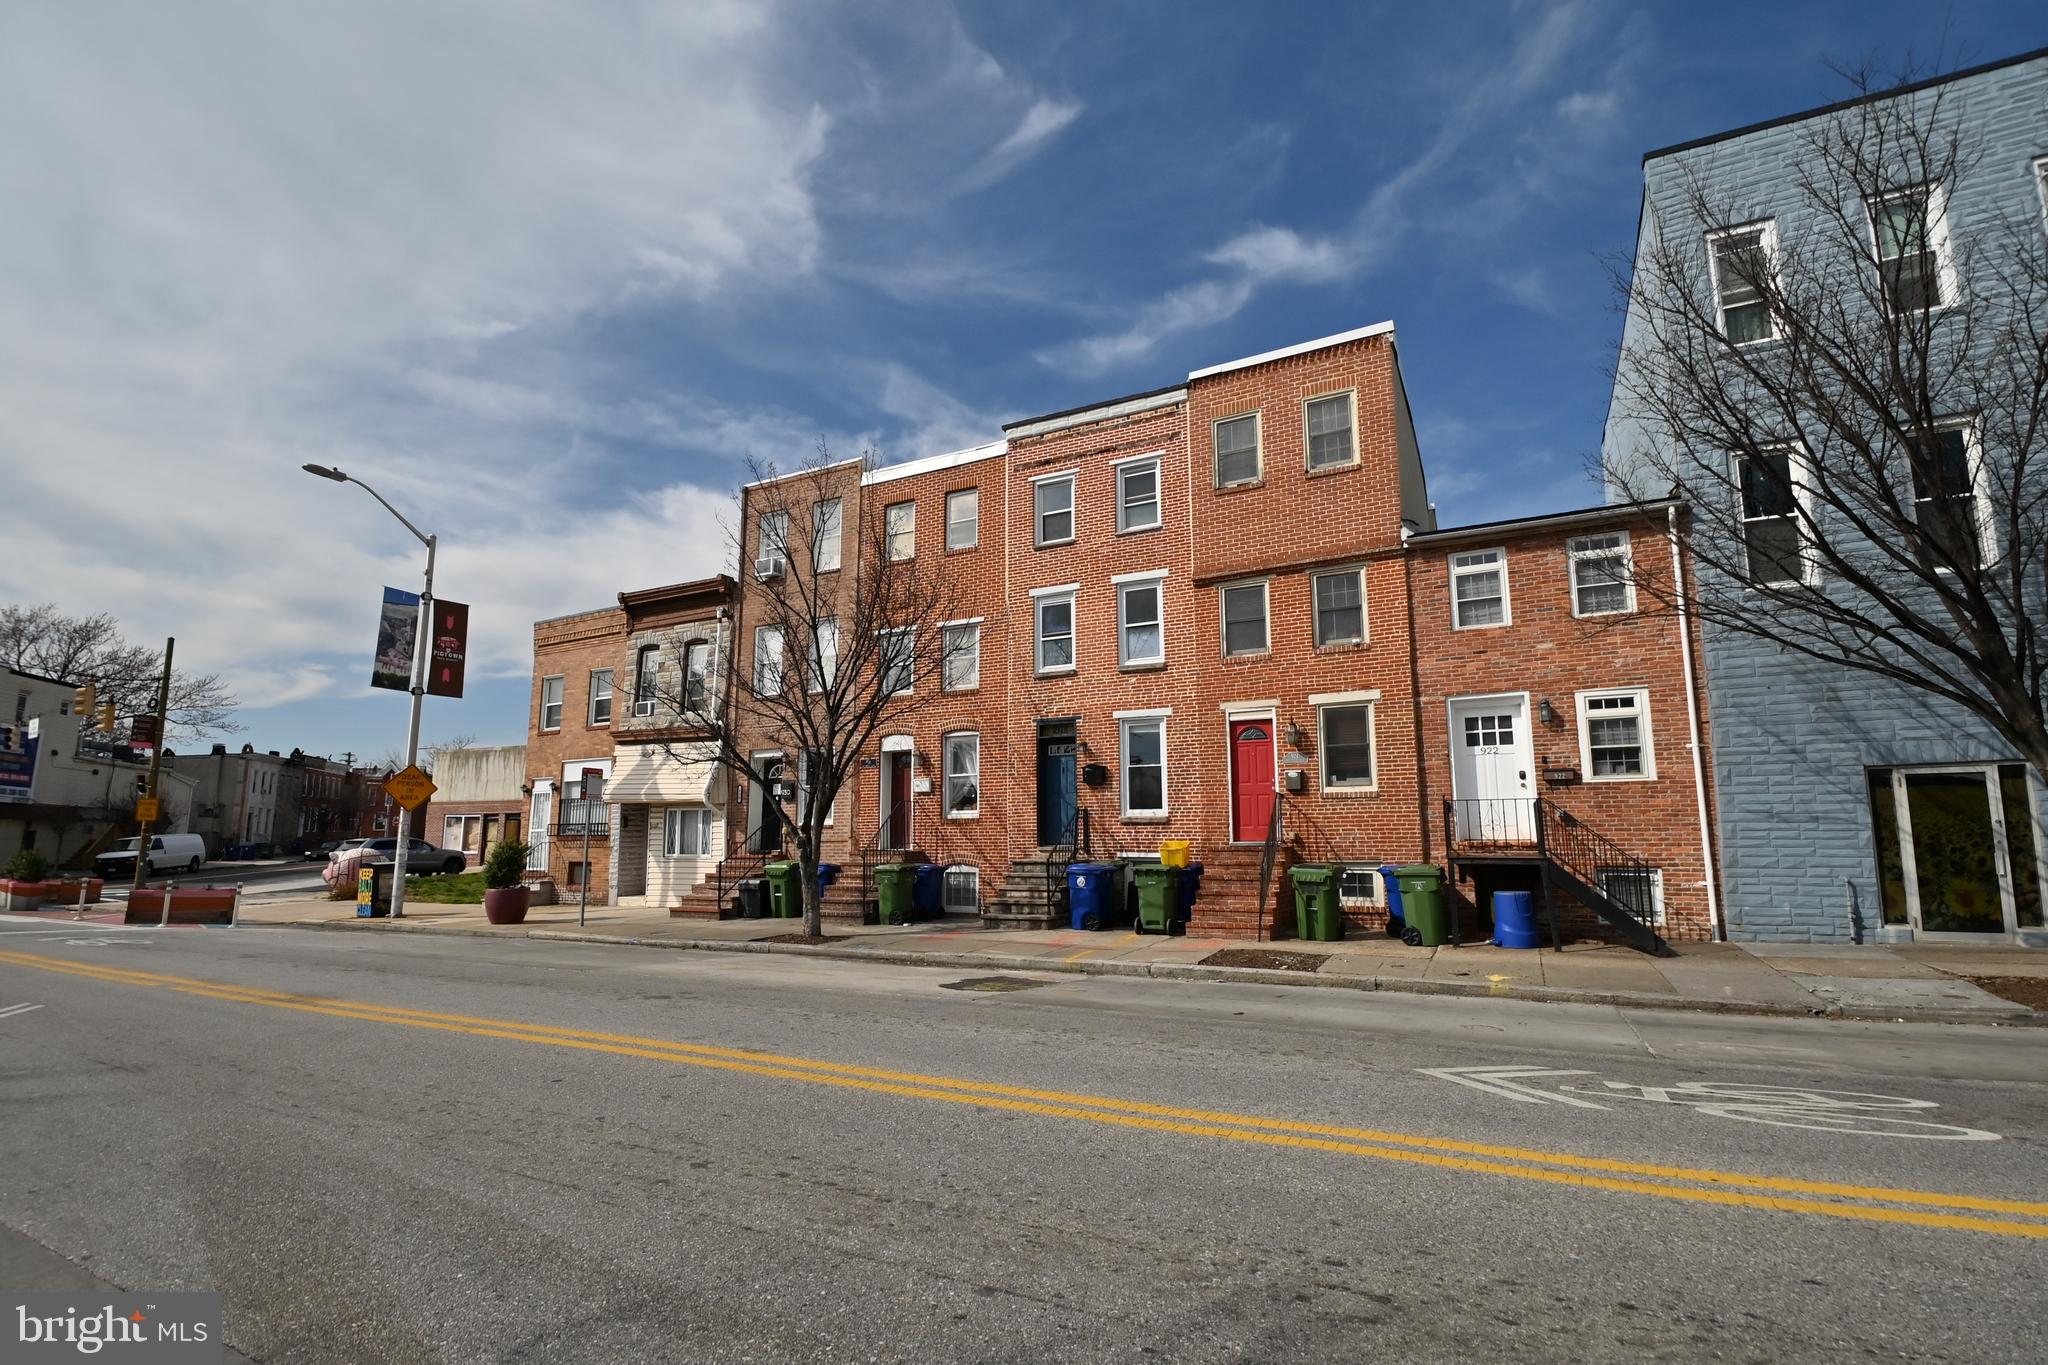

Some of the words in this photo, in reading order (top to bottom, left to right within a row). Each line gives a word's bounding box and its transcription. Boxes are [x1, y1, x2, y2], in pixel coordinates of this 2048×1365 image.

[433, 650, 463, 660] PIGTOWN
[1480, 746, 1499, 755] 922
[359, 868, 373, 880] KEEP
[358, 891, 372, 905] MORE
[357, 904, 372, 917] CLEAN
